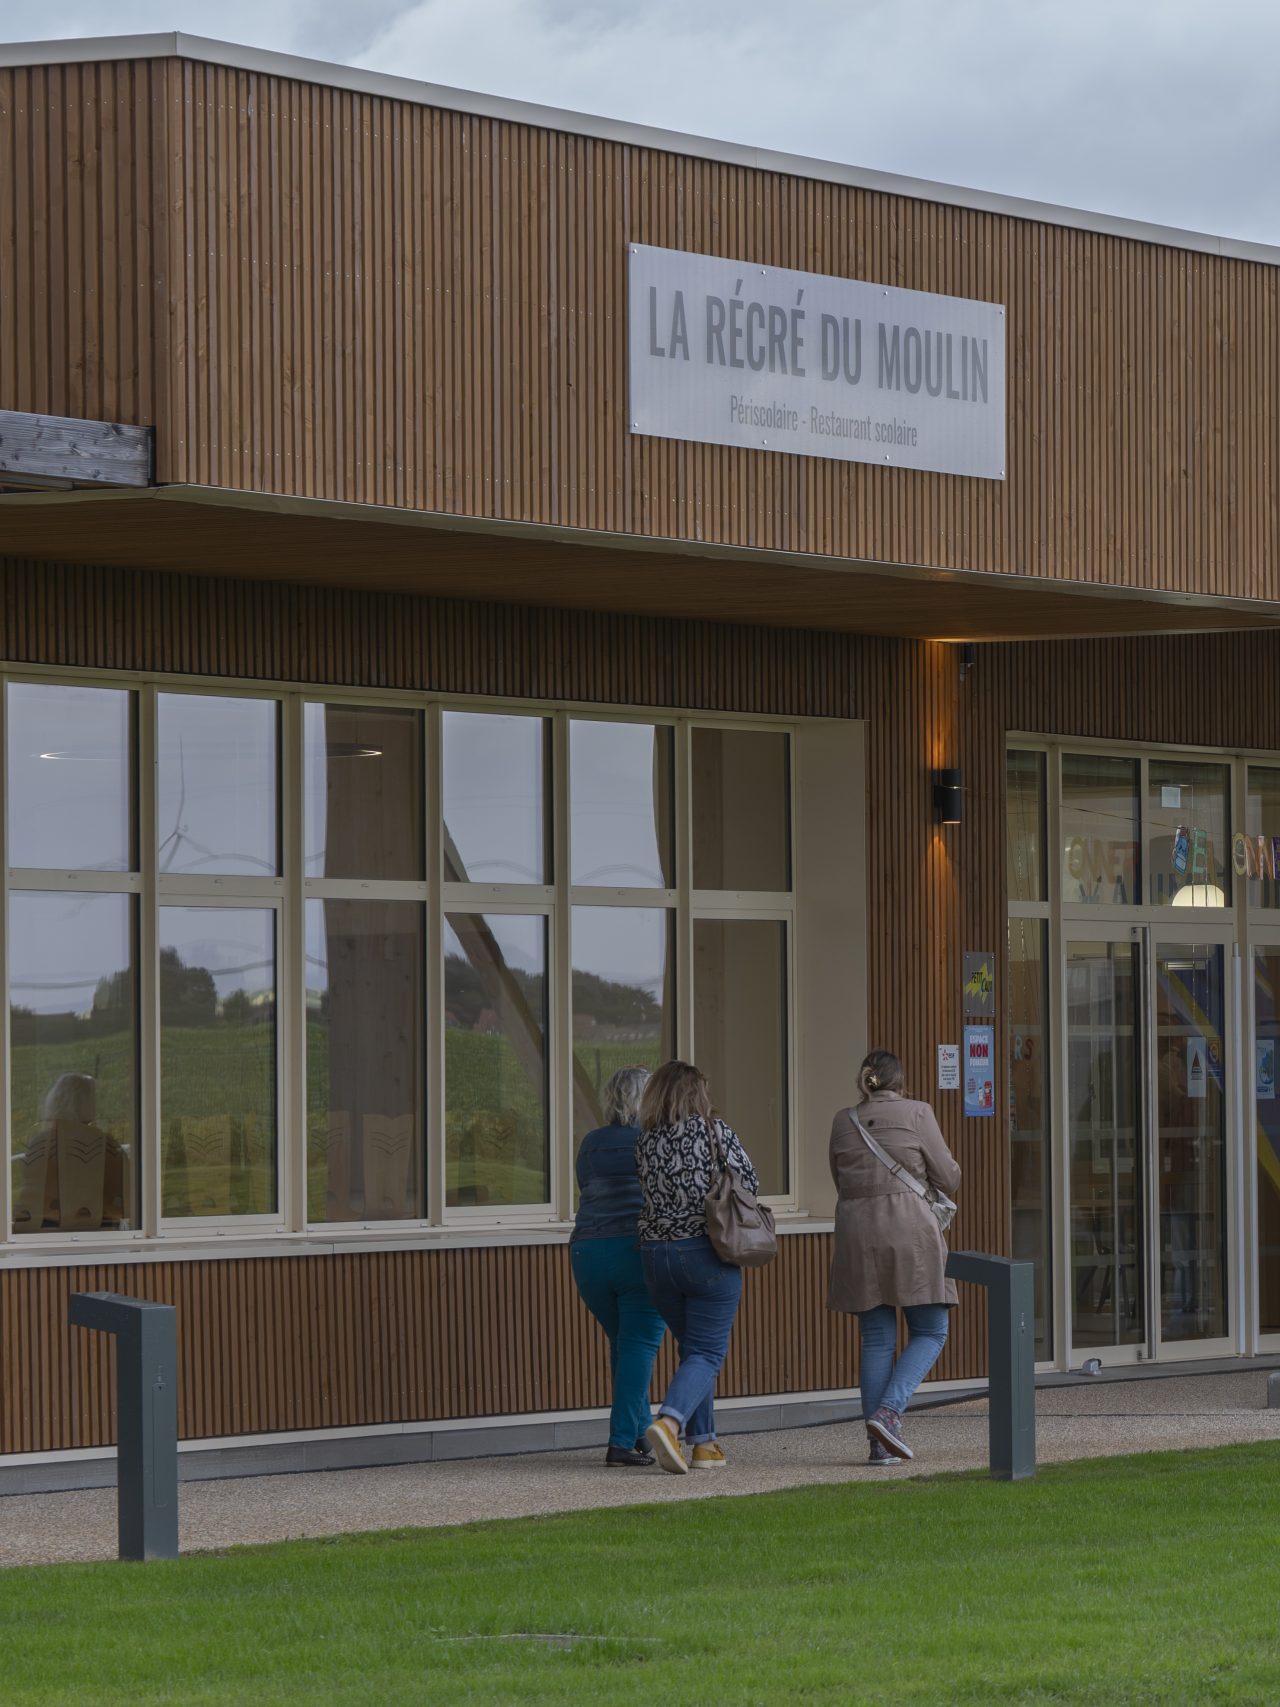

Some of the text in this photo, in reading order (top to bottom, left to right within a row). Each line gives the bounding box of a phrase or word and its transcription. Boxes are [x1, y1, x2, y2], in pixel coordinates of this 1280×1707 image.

[650, 278, 988, 404] LA RÉCRÉ DU MOULIN
[730, 395, 798, 432] Périscolaire
[811, 406, 872, 441] Restaurant
[875, 417, 917, 447] scolaire
[969, 1043, 989, 1057] NON
